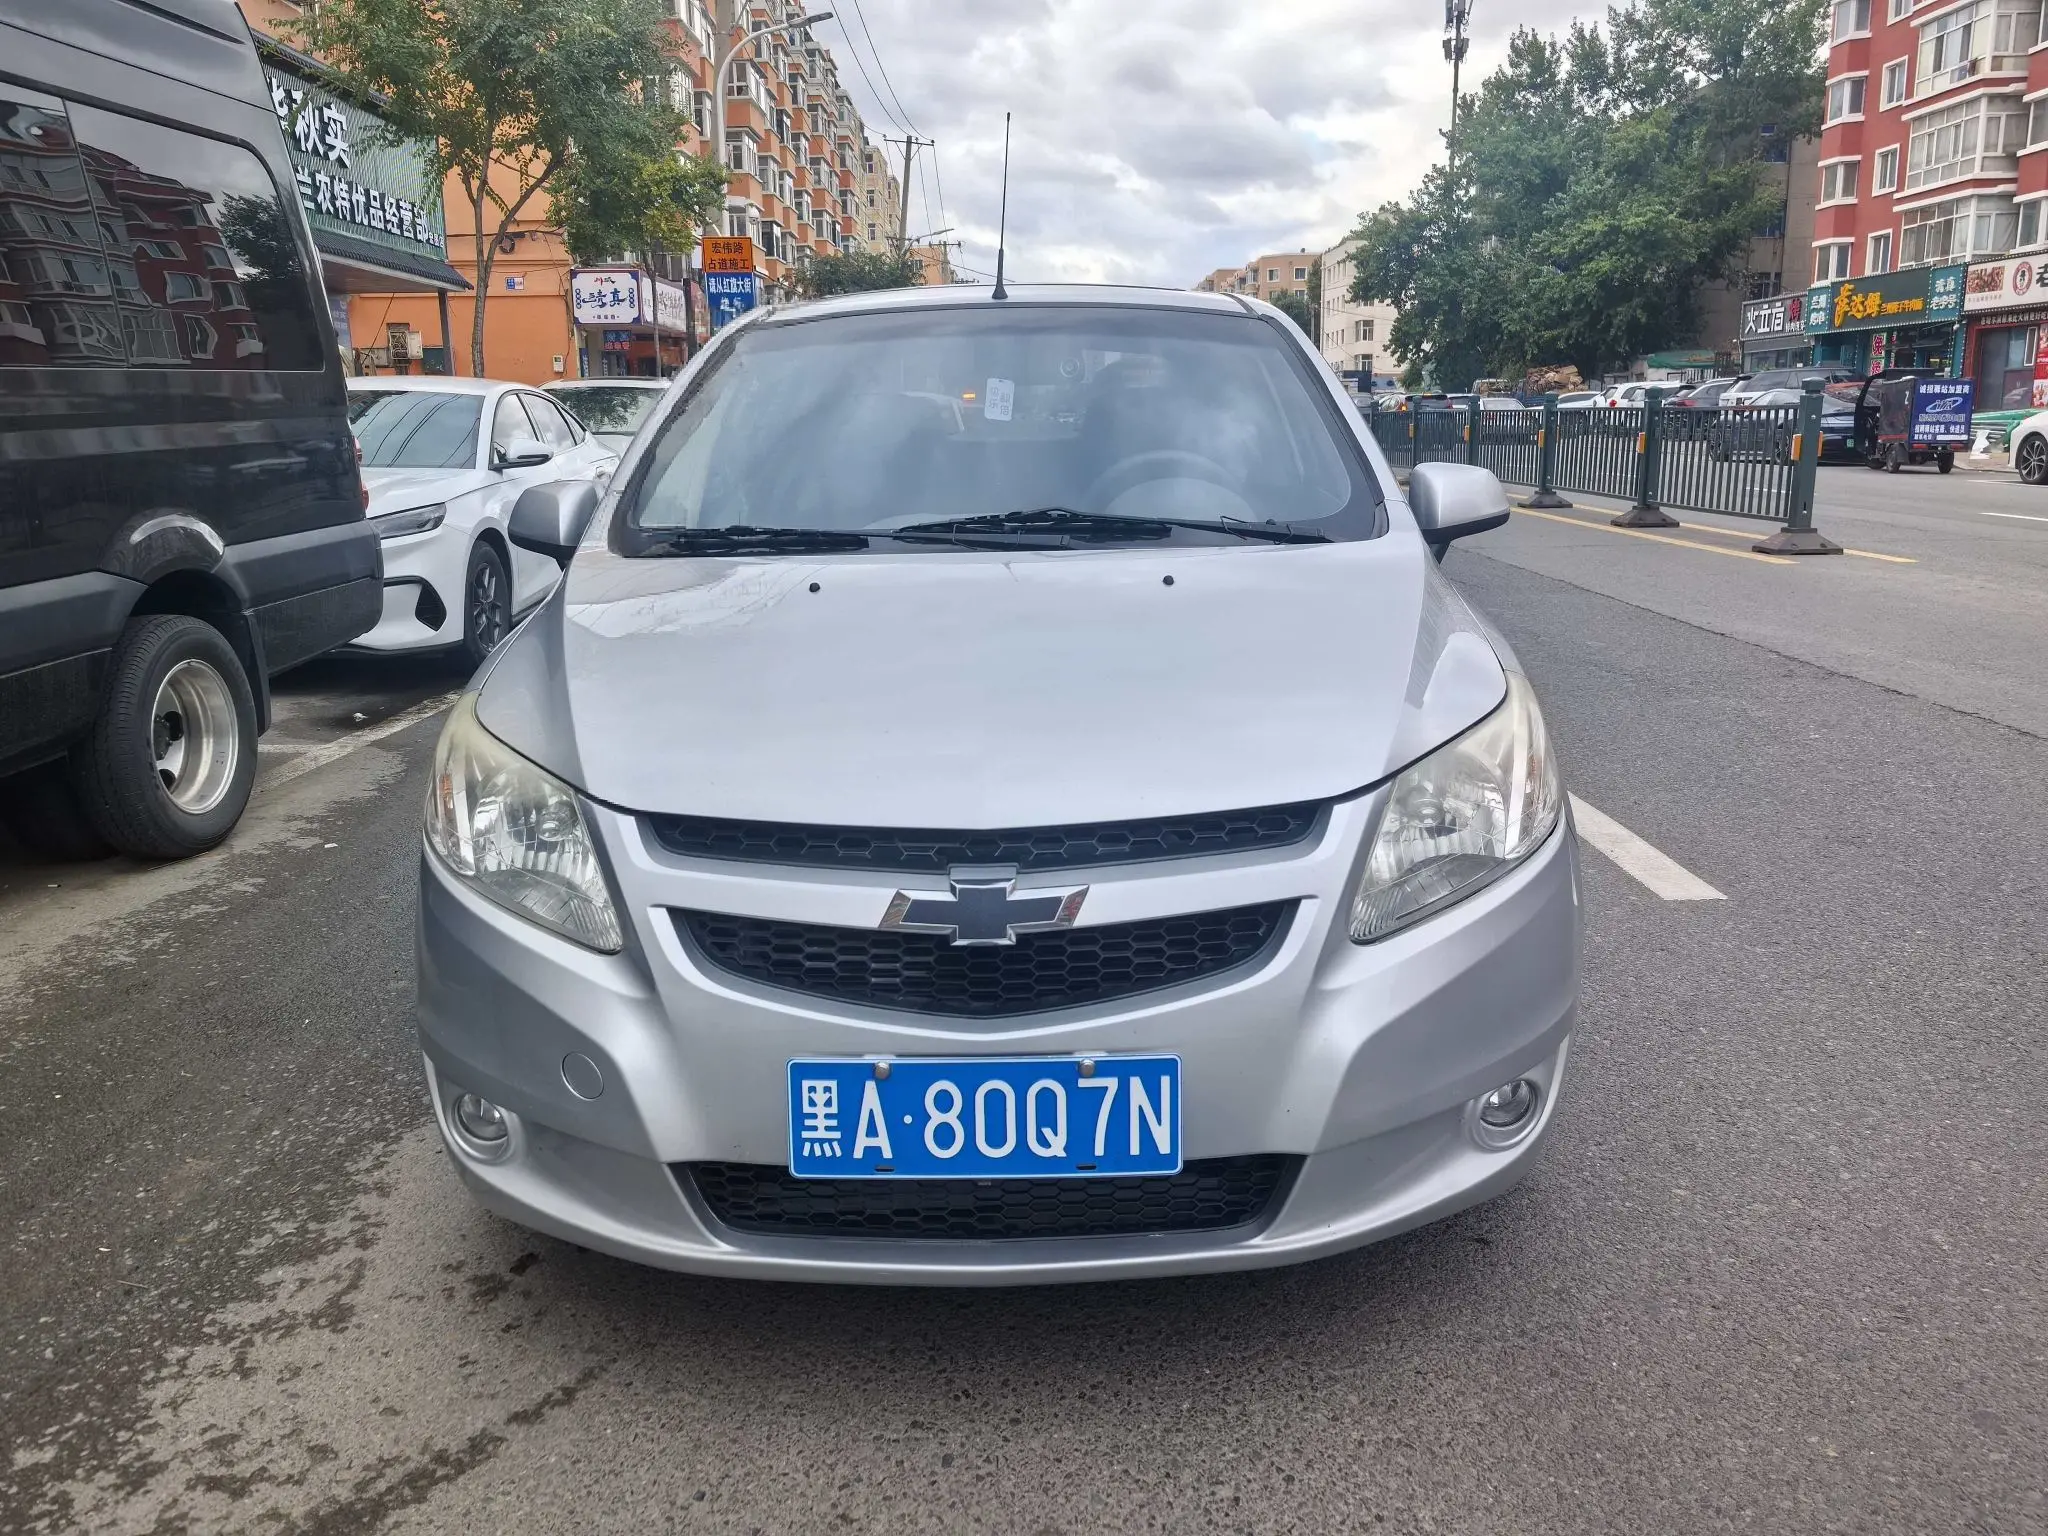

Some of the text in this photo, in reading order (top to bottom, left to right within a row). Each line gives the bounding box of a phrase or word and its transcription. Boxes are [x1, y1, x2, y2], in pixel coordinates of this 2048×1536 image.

[712, 242, 743, 254] 宏伟路
[708, 258, 749, 270] 占道施工
[708, 277, 752, 294] 请从红旗大街
[801, 1075, 1172, 1160] 黑A·80Q7N
